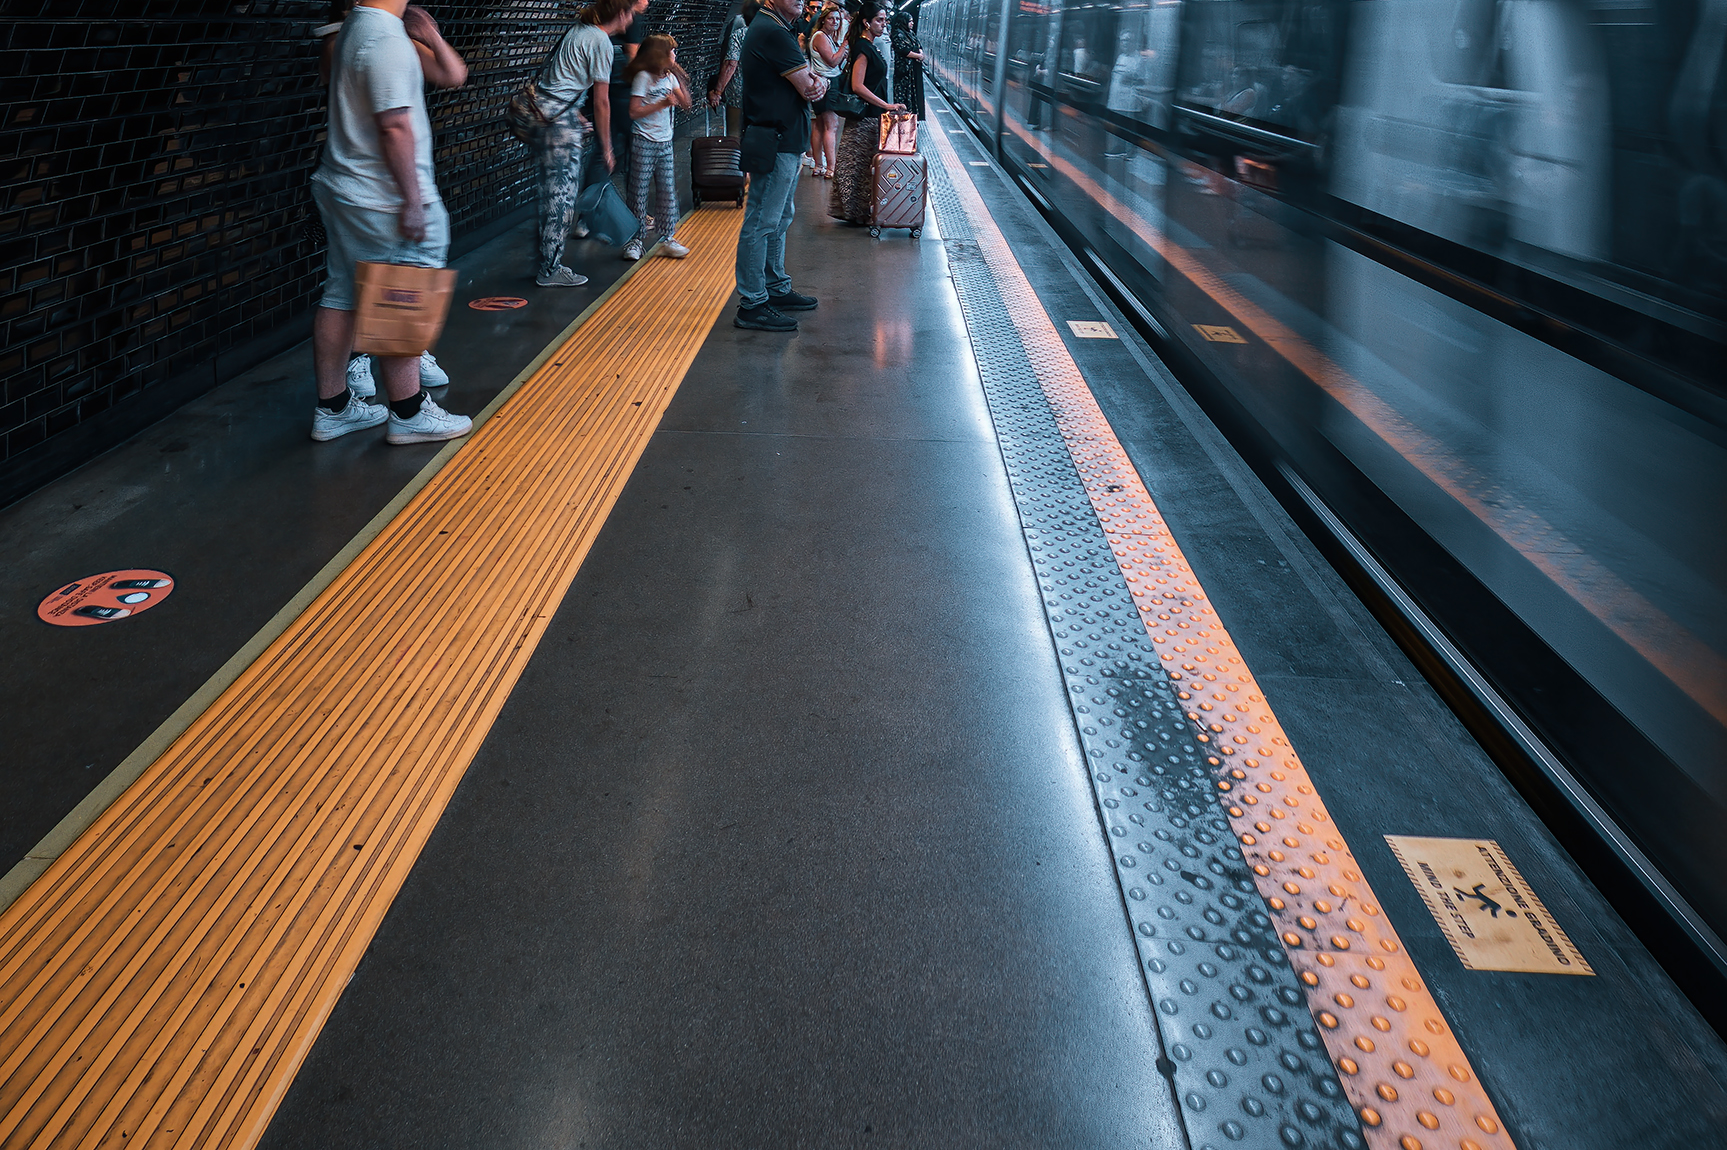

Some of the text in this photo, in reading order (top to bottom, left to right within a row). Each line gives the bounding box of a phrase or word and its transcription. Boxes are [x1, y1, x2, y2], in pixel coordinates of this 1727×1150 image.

[1417, 860, 1475, 939] MIND THE STEP
[1475, 844, 1571, 966] ATTENZIONE GRADINO
